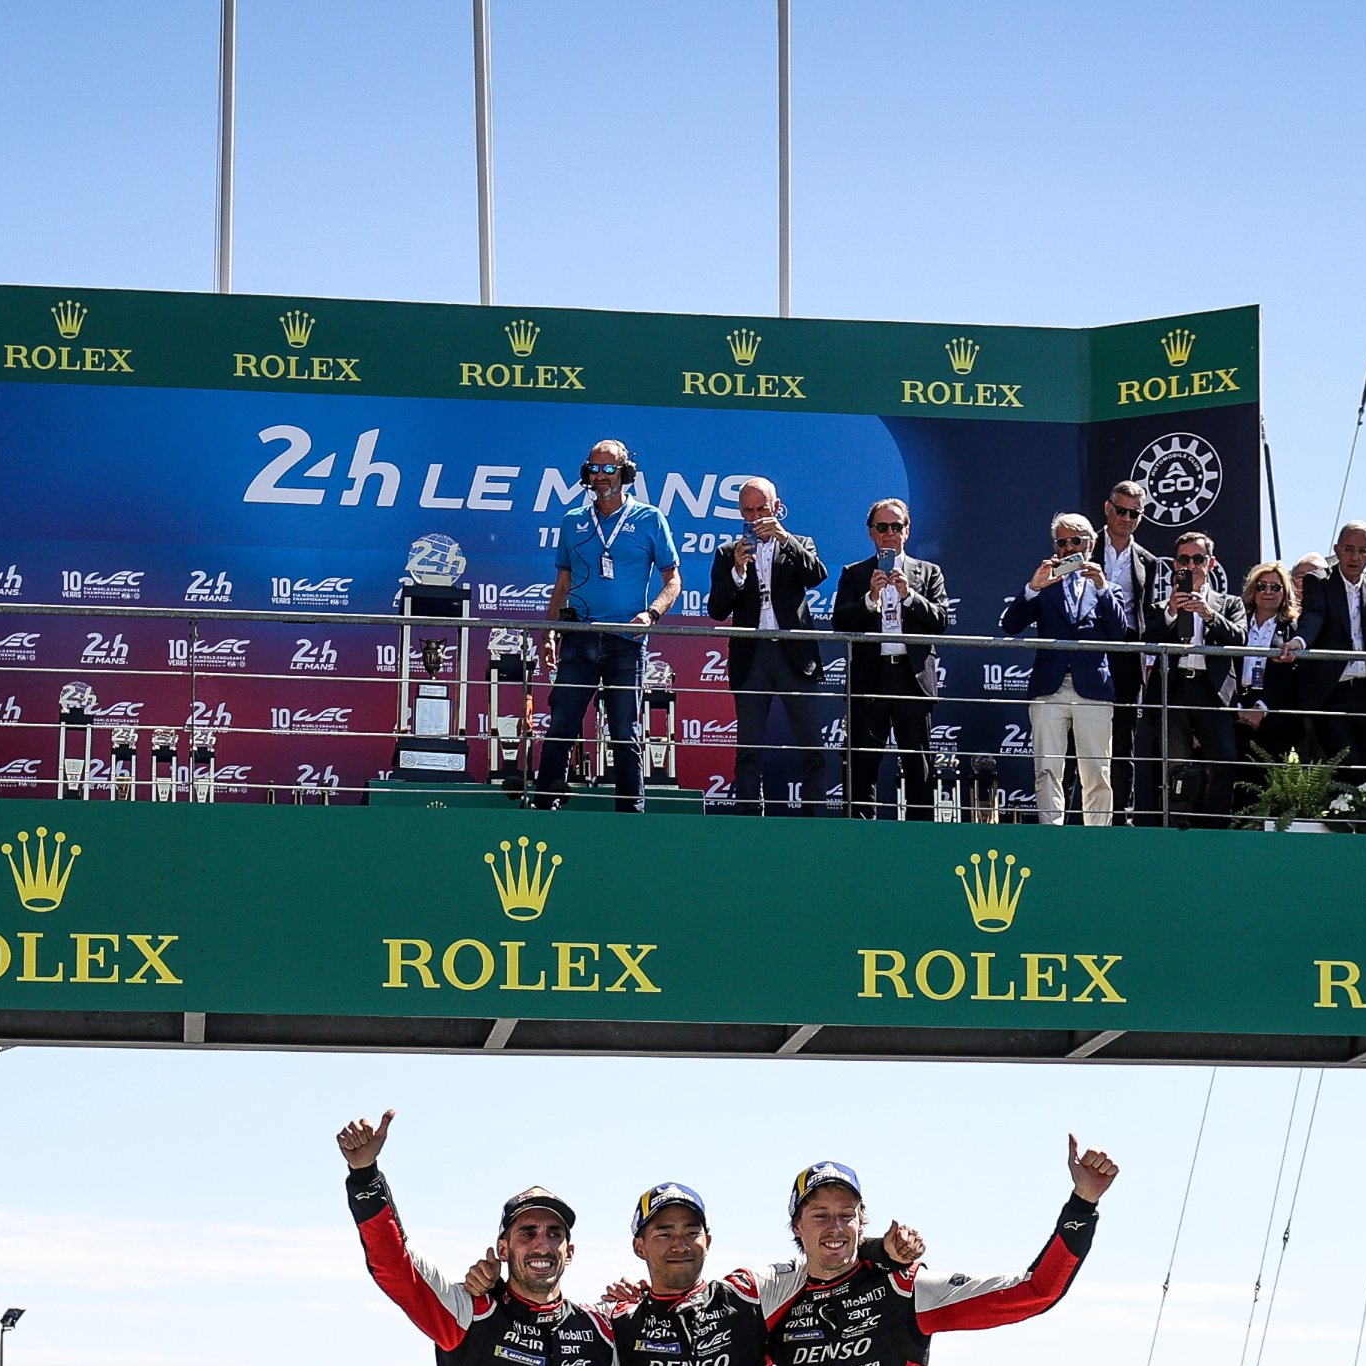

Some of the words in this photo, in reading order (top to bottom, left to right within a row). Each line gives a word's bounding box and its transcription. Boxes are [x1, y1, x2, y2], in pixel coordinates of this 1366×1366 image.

[4, 345, 134, 374] ROLEX
[233, 353, 361, 382] ROLEX
[459, 362, 586, 390] ROLEX
[682, 372, 806, 399] ROLEX
[1118, 367, 1240, 404] ROLEX
[901, 380, 1024, 408] ROLEX
[243, 425, 402, 507] 24h
[419, 463, 521, 510] LE
[62, 571, 81, 591] 10
[84, 571, 145, 585] WEC
[186, 570, 233, 595] 24h
[272, 577, 290, 597] 10
[293, 577, 353, 591] WEC
[478, 584, 497, 603] 10
[682, 590, 701, 609] 10
[83, 633, 129, 657] 24h
[168, 640, 187, 659] 10
[292, 639, 337, 663] 24h
[377, 645, 395, 665] 10
[984, 664, 1001, 683] 10
[293, 707, 352, 722] WEC
[382, 937, 663, 995] ROLEX
[857, 949, 1127, 1004] ROLEX
[697, 1329, 731, 1350] WEC
[793, 1337, 872, 1364] DENSO
[509, 1352, 541, 1365] MICHELIN
